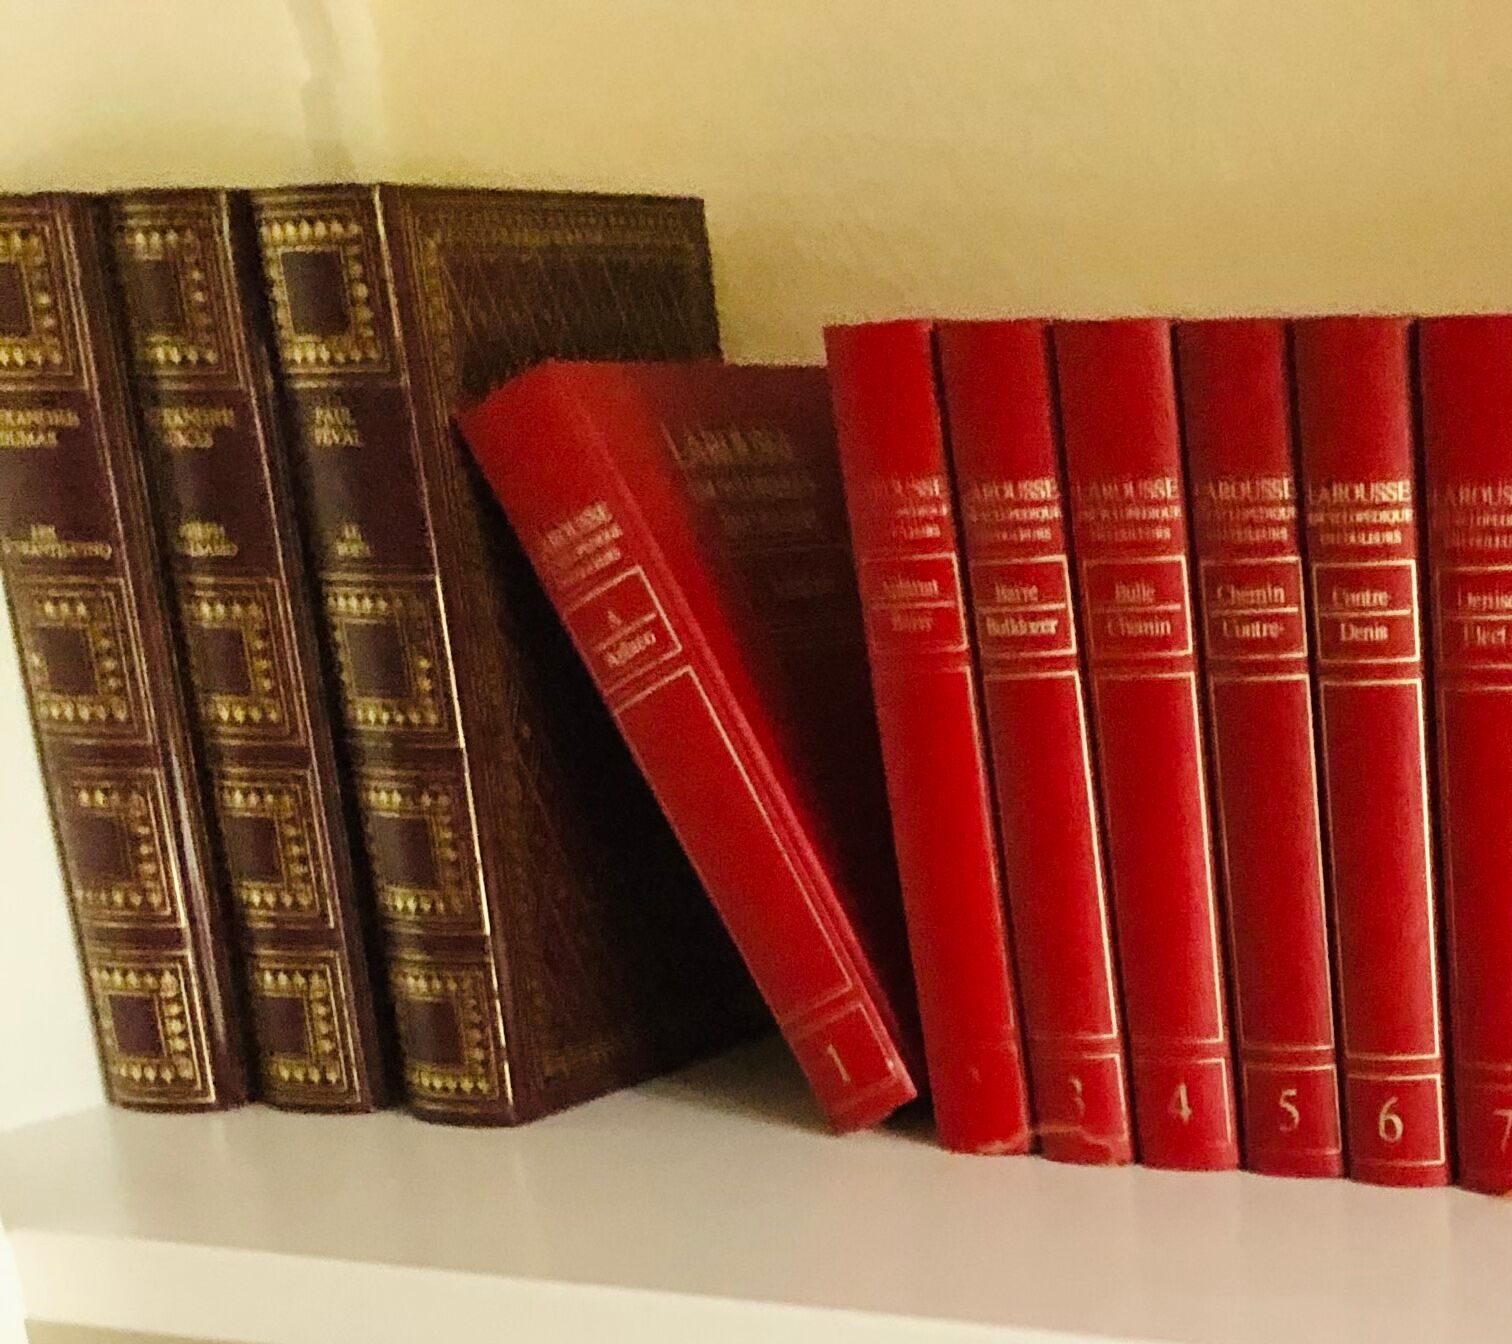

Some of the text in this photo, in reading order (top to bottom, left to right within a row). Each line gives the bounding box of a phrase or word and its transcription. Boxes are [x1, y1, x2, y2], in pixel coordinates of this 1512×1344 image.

[1167, 1081, 1193, 1124] 4
[1278, 1088, 1301, 1132] 5
[1378, 1095, 1404, 1143] 6
